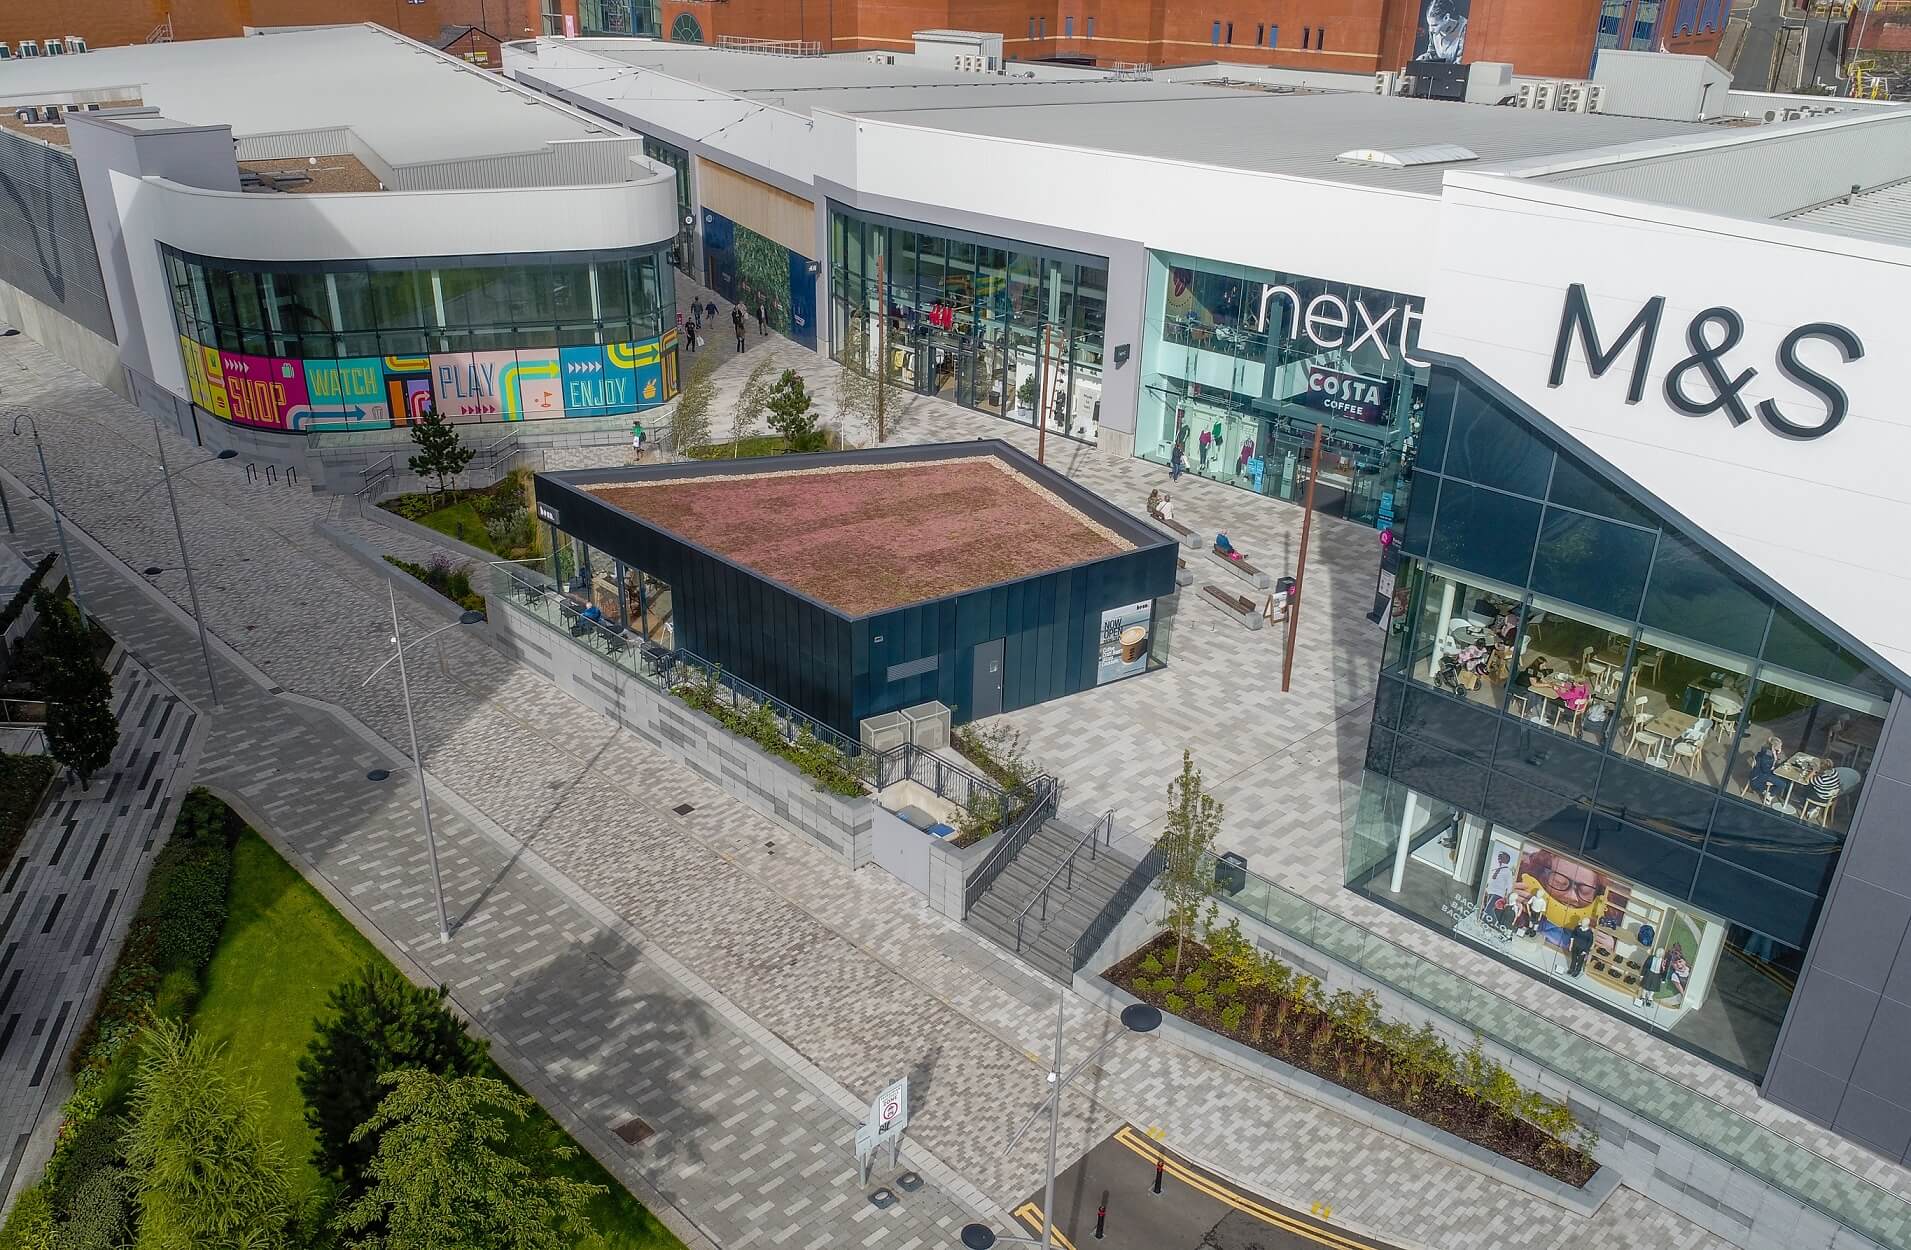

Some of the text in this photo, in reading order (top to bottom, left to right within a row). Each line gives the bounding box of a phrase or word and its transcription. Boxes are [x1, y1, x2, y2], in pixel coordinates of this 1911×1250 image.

[1258, 284, 1431, 367] next
[1547, 282, 1865, 441] M&S
[309, 368, 378, 397] WATCH
[438, 362, 495, 400] PLAY
[570, 376, 626, 407] ENJOY
[1309, 373, 1380, 405] COSTA
[227, 376, 286, 423] SHOP
[1323, 399, 1363, 415] COFFEE
[1103, 627, 1122, 639] OPEN
[1104, 616, 1122, 630] NOW
